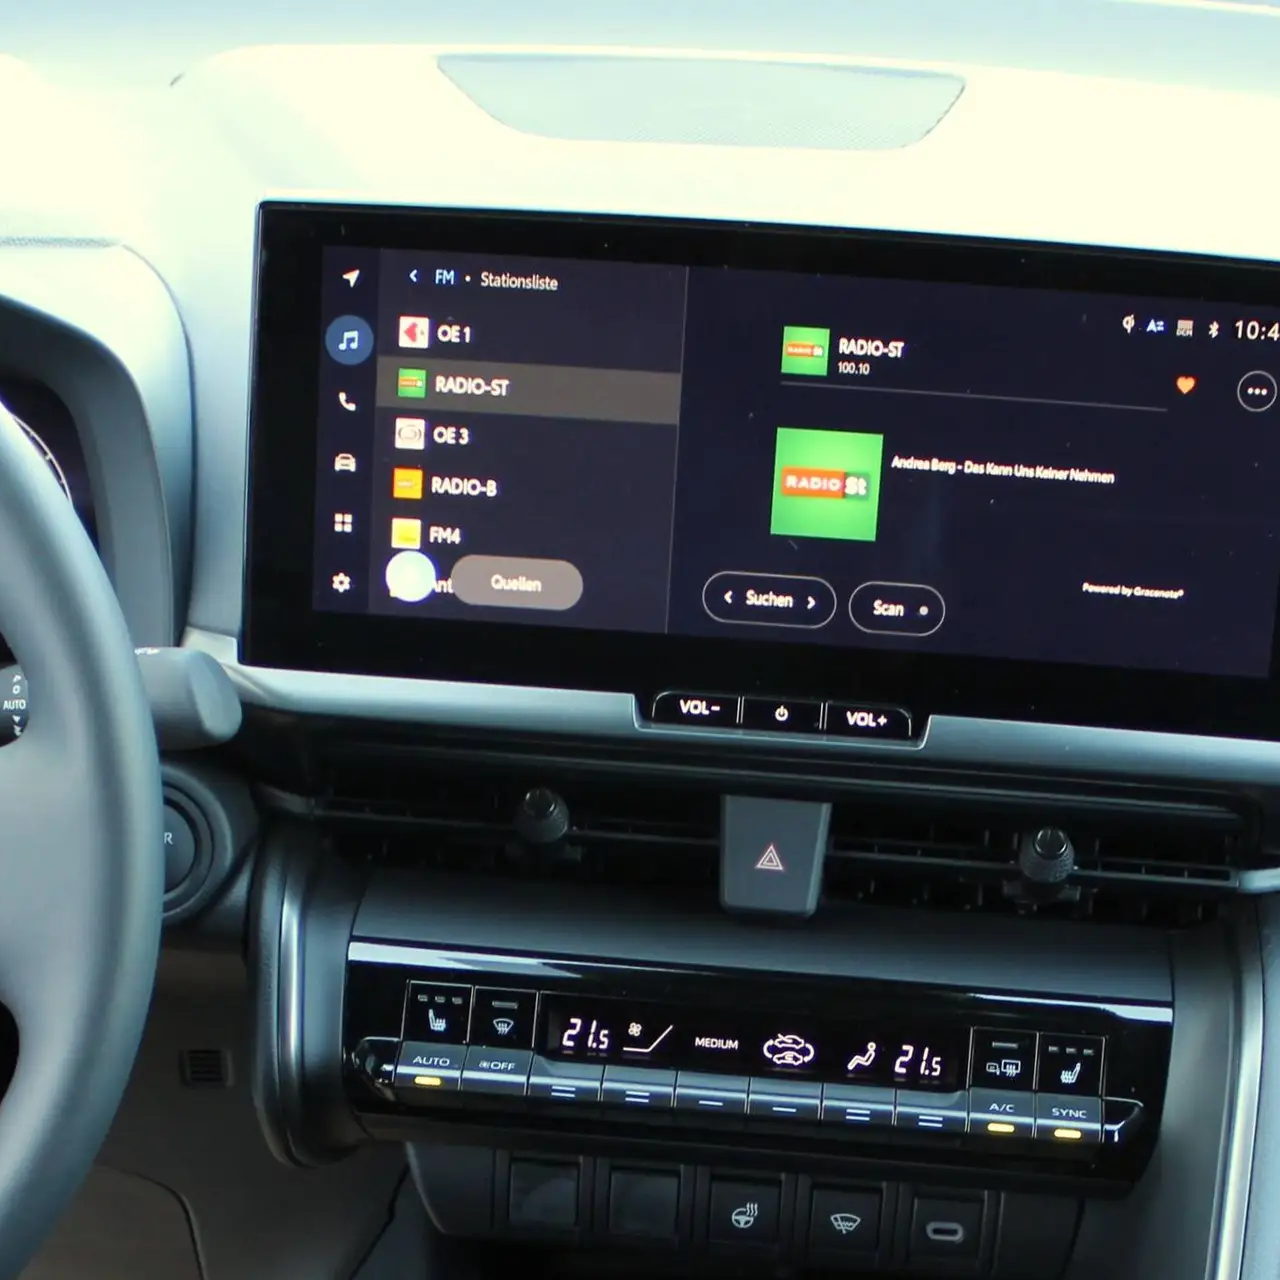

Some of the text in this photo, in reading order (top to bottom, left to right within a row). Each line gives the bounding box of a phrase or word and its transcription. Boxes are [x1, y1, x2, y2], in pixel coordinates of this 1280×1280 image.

[435, 269, 559, 291] FM Stationsliste
[437, 324, 471, 343] OE 1
[839, 338, 905, 358] RADIO-ST
[838, 361, 870, 375] 100.10
[435, 375, 510, 396] RADIO-ST
[433, 426, 470, 445] OE 3
[891, 455, 930, 470] Andrea
[931, 458, 956, 475] Berg
[964, 460, 985, 475] Das
[986, 462, 1013, 477] Kann
[1014, 464, 1035, 478] Uns
[1035, 466, 1069, 481] Keiner
[1070, 468, 1115, 484] Nehmen
[431, 476, 498, 497] RADIO-B
[785, 473, 868, 496] RADIO St
[429, 525, 461, 545] FM4
[491, 574, 542, 593] Quellen
[1082, 583, 1120, 595] Powered
[1121, 585, 1132, 598] by
[745, 588, 793, 608] Suchen
[873, 600, 905, 617] Scan
[2, 699, 26, 711] AUTO
[562, 1017, 609, 1050] 21.5
[694, 1036, 739, 1050] MEDIUM
[412, 1056, 450, 1068] AUTO
[490, 1060, 516, 1071] OFF
[893, 1044, 941, 1077] 21.5
[989, 1102, 1015, 1114] A/C
[1051, 1107, 1088, 1119] SYNC
